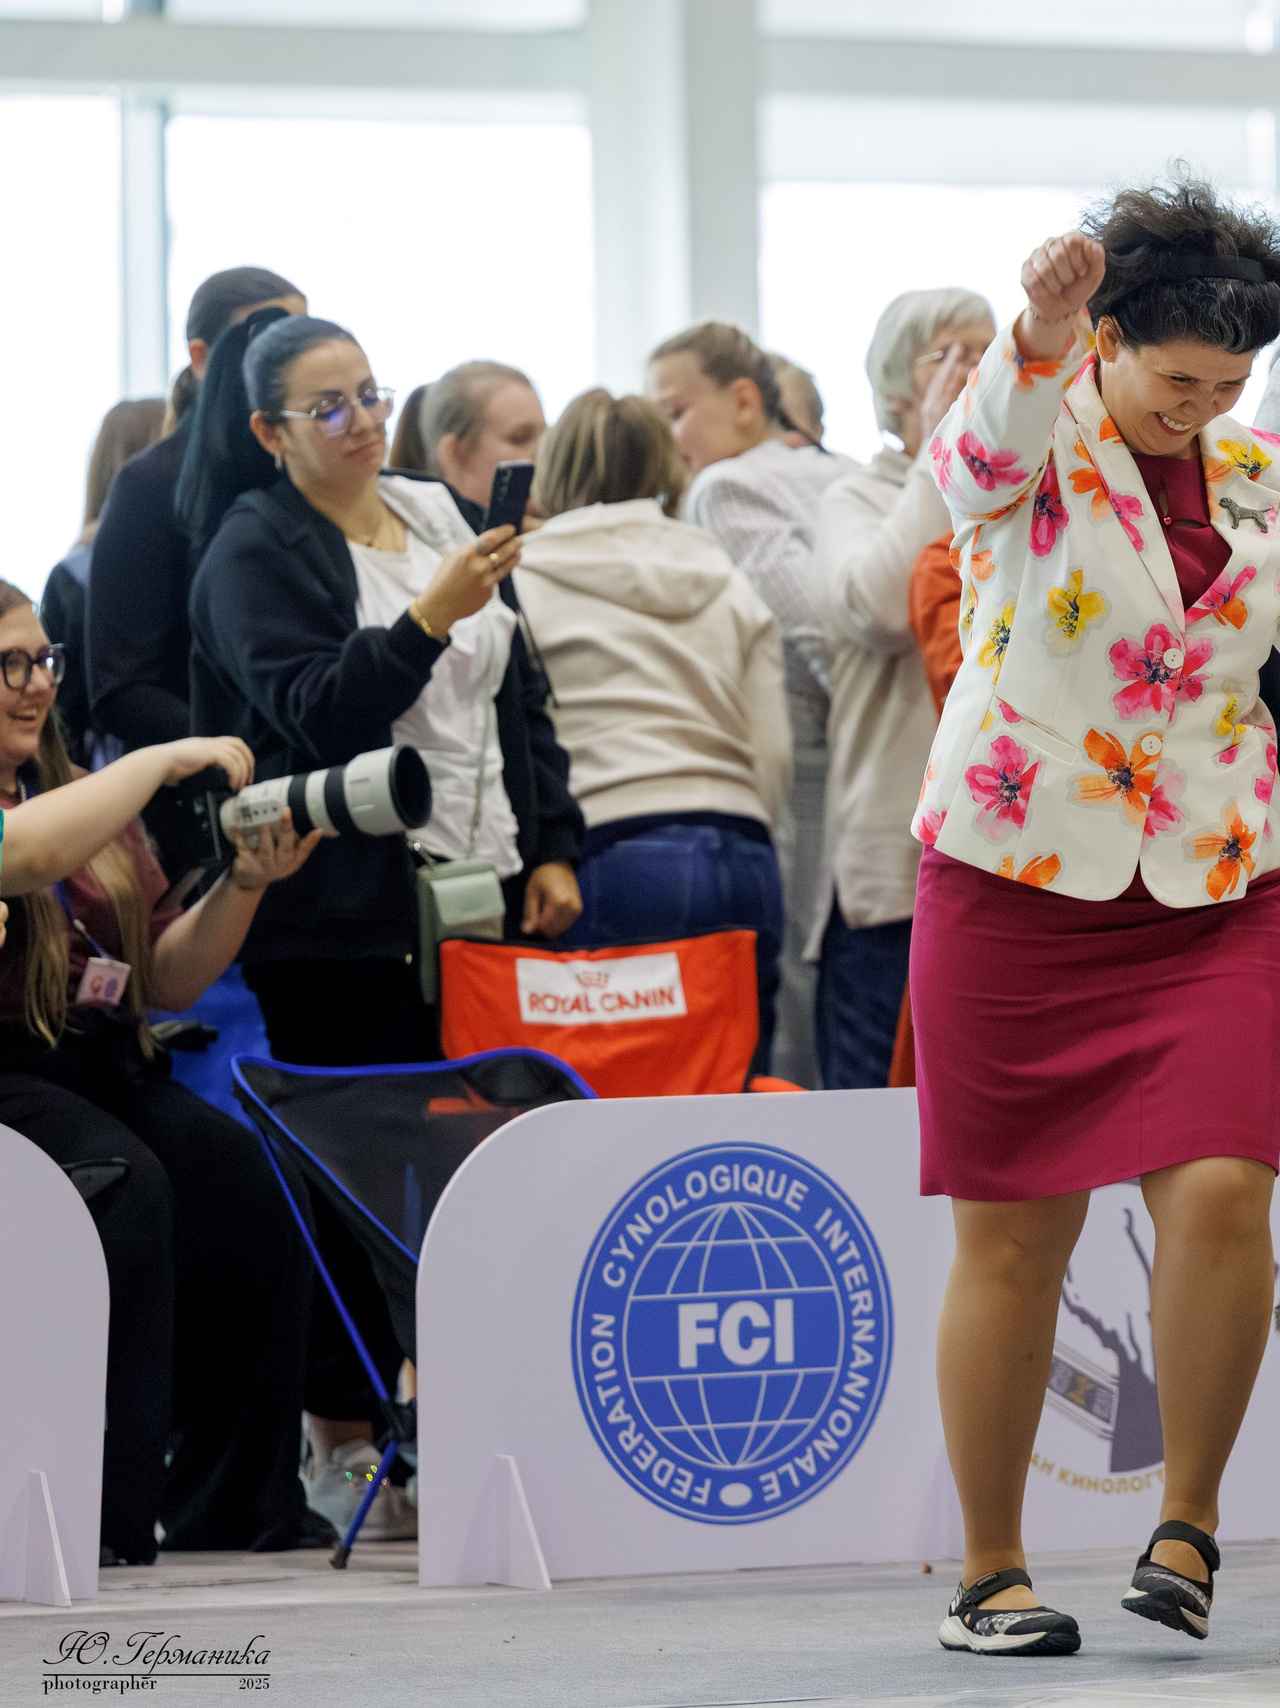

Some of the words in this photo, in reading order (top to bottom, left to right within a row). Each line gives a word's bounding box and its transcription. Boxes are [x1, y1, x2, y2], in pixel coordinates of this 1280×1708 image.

[528, 992, 594, 1015] ROYAL
[601, 986, 676, 1012] CANIN
[602, 1163, 809, 1289] CYNOLOGIQUE
[678, 1298, 795, 1368] FCI
[591, 1312, 713, 1506] FEDERATION
